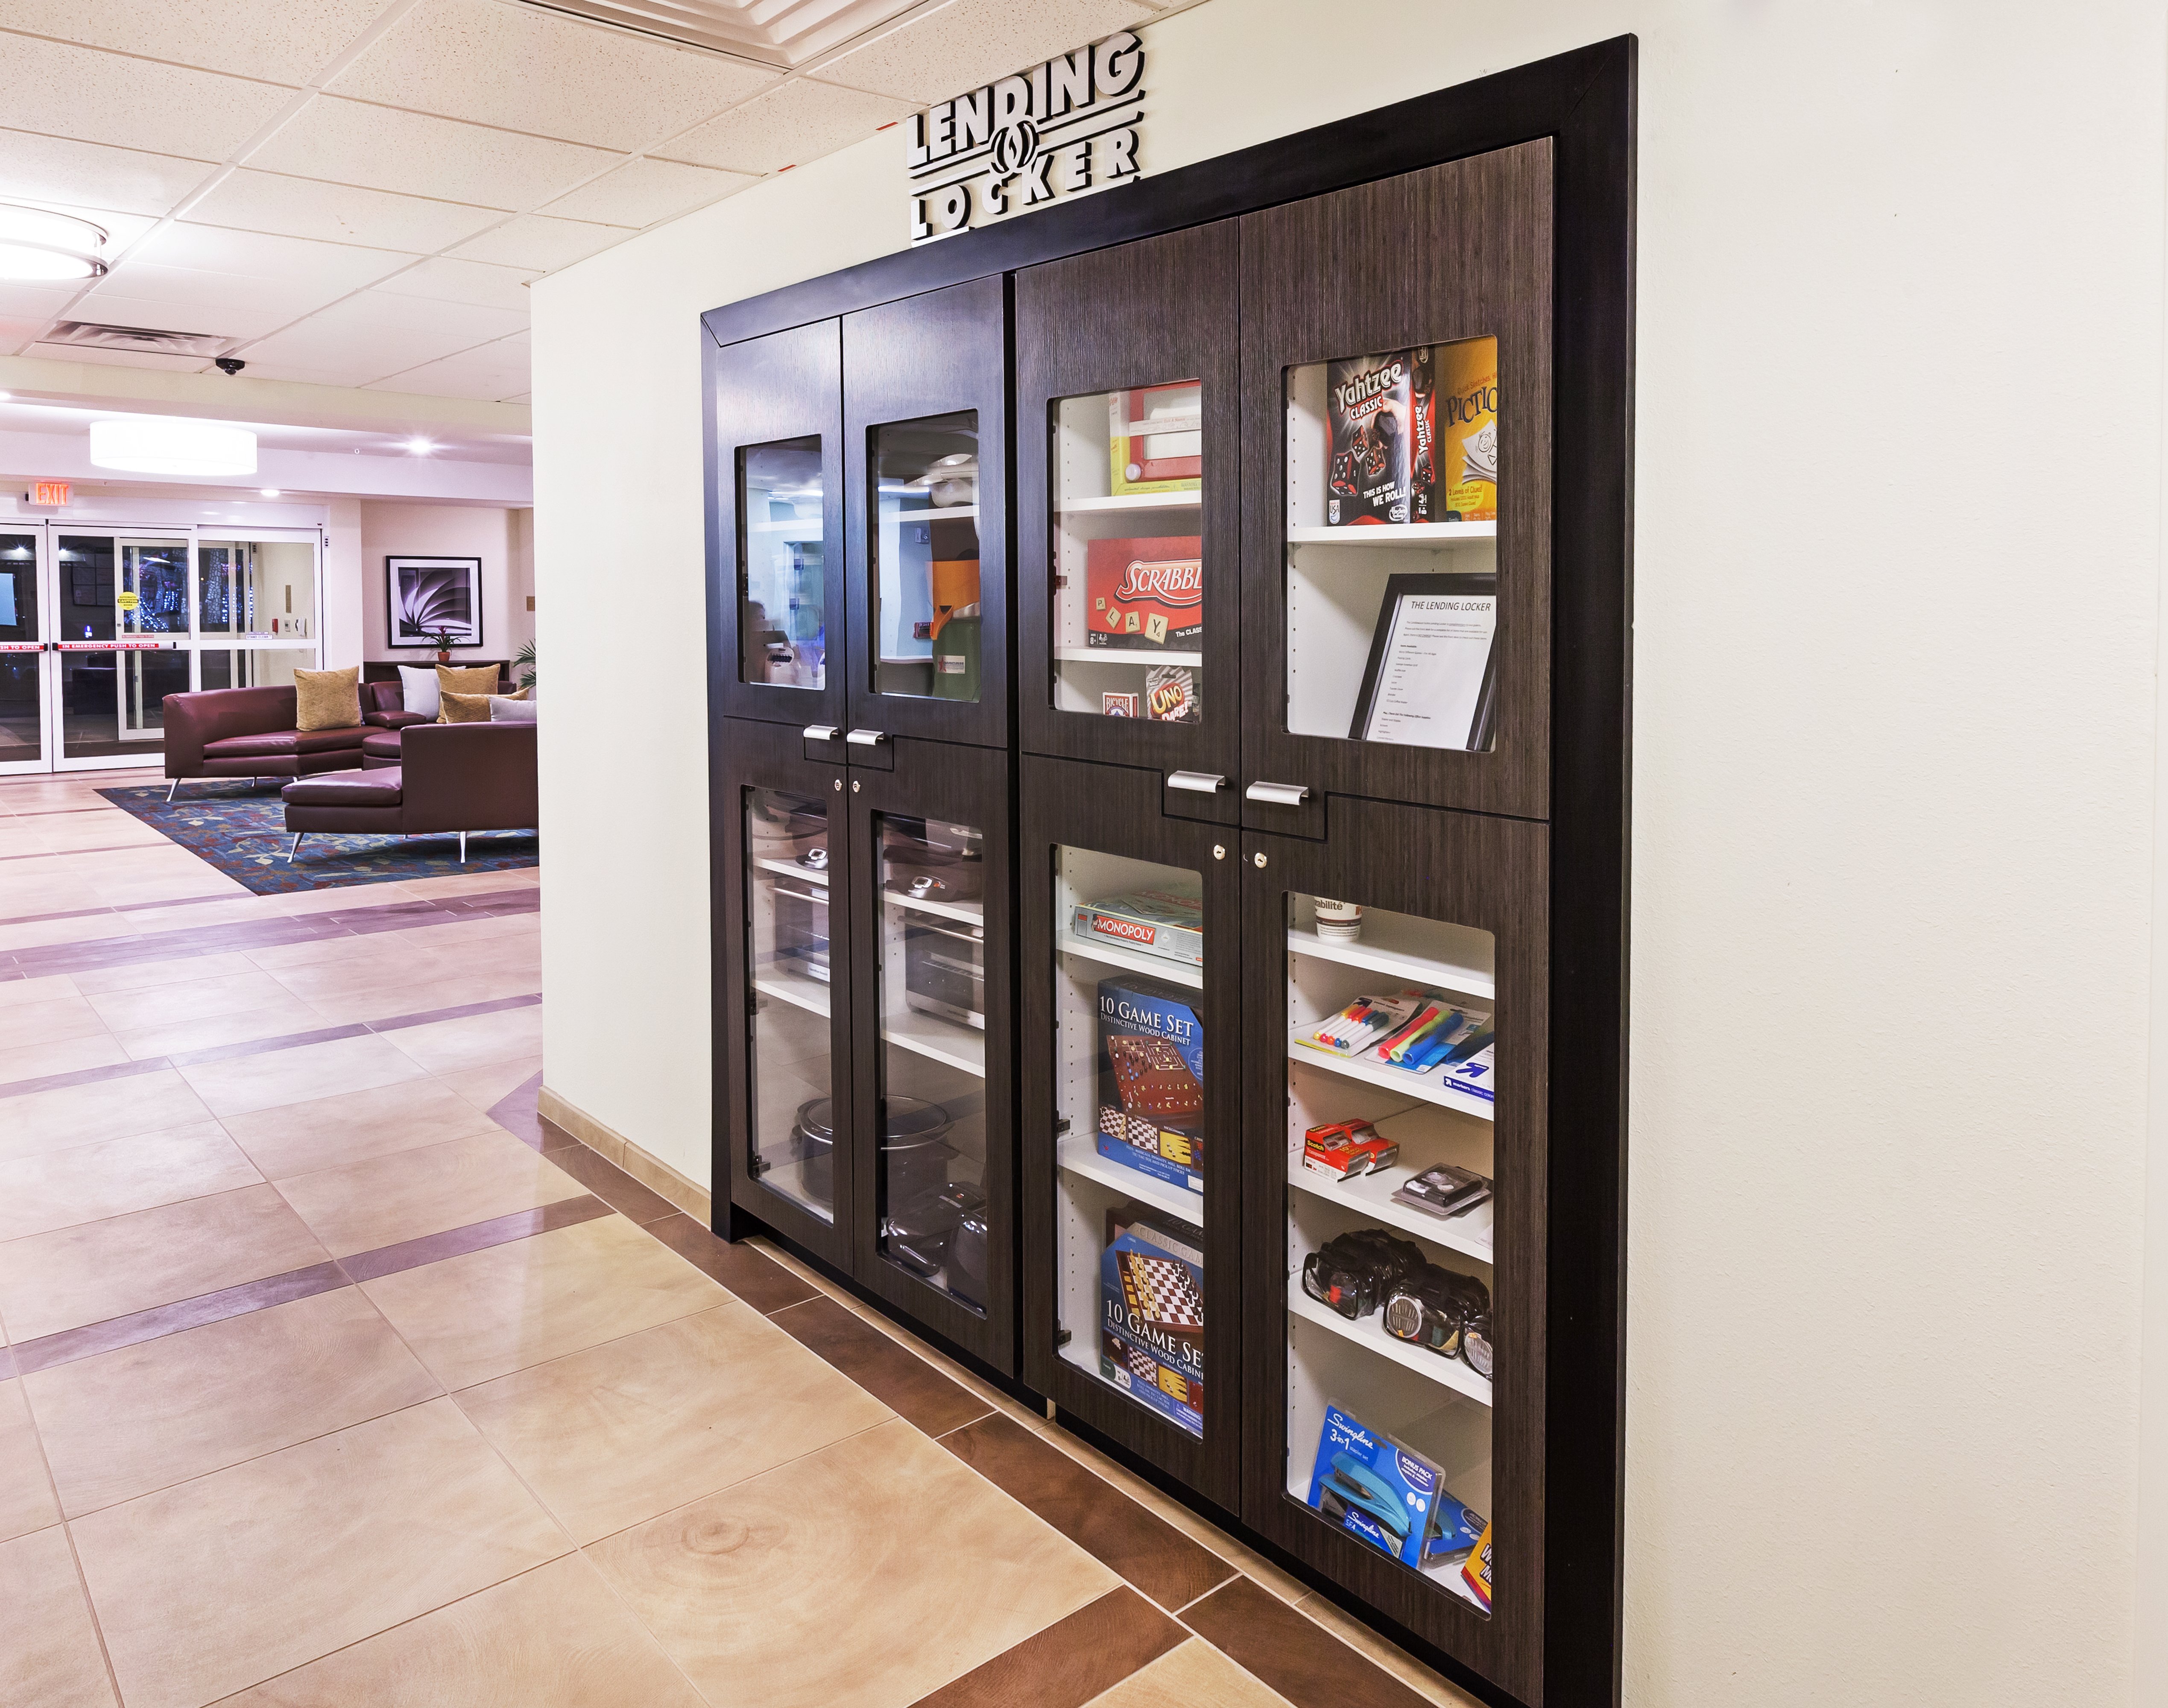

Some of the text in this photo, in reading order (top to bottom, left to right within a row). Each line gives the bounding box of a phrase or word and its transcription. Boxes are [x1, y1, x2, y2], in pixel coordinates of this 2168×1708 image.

[907, 32, 1145, 170] LENDING
[910, 128, 1141, 240] LOCKER
[1335, 363, 1402, 412] Yahtzee
[1350, 396, 1383, 420] CLASSIC
[1415, 406, 1428, 454] Yahtzee
[36, 483, 69, 505] EXIT
[1363, 488, 1375, 499] THIS
[1382, 481, 1395, 492] HOW
[1372, 486, 1406, 507] WE ROLL!
[1330, 505, 1340, 514] USA
[1411, 601, 1491, 611] THE LENDING LOCKER
[1106, 697, 1129, 714] BICYCLE
[1150, 685, 1182, 714] UNO
[1097, 918, 1153, 941] MONOPOLY
[1100, 996, 1194, 1037] 10 GAME SET
[1101, 1012, 1191, 1046] DISTINCTIVE WOOD CABINET
[1452, 1082, 1470, 1091] markers
[1307, 1140, 1324, 1151] Scotch
[1139, 1227, 1178, 1252] CLASSIC
[1107, 1300, 1123, 1323] 10
[1127, 1313, 1176, 1355] GAME
[1182, 1342, 1203, 1368] SE
[1107, 1318, 1149, 1350] DISTINCTIVE
[1150, 1343, 1175, 1364] WOOD
[1327, 1413, 1374, 1450] Swingline
[1330, 1429, 1349, 1450] 3-in-1
[1401, 1456, 1433, 1480] BONUS PACK
[1348, 1512, 1379, 1539] Swingline
